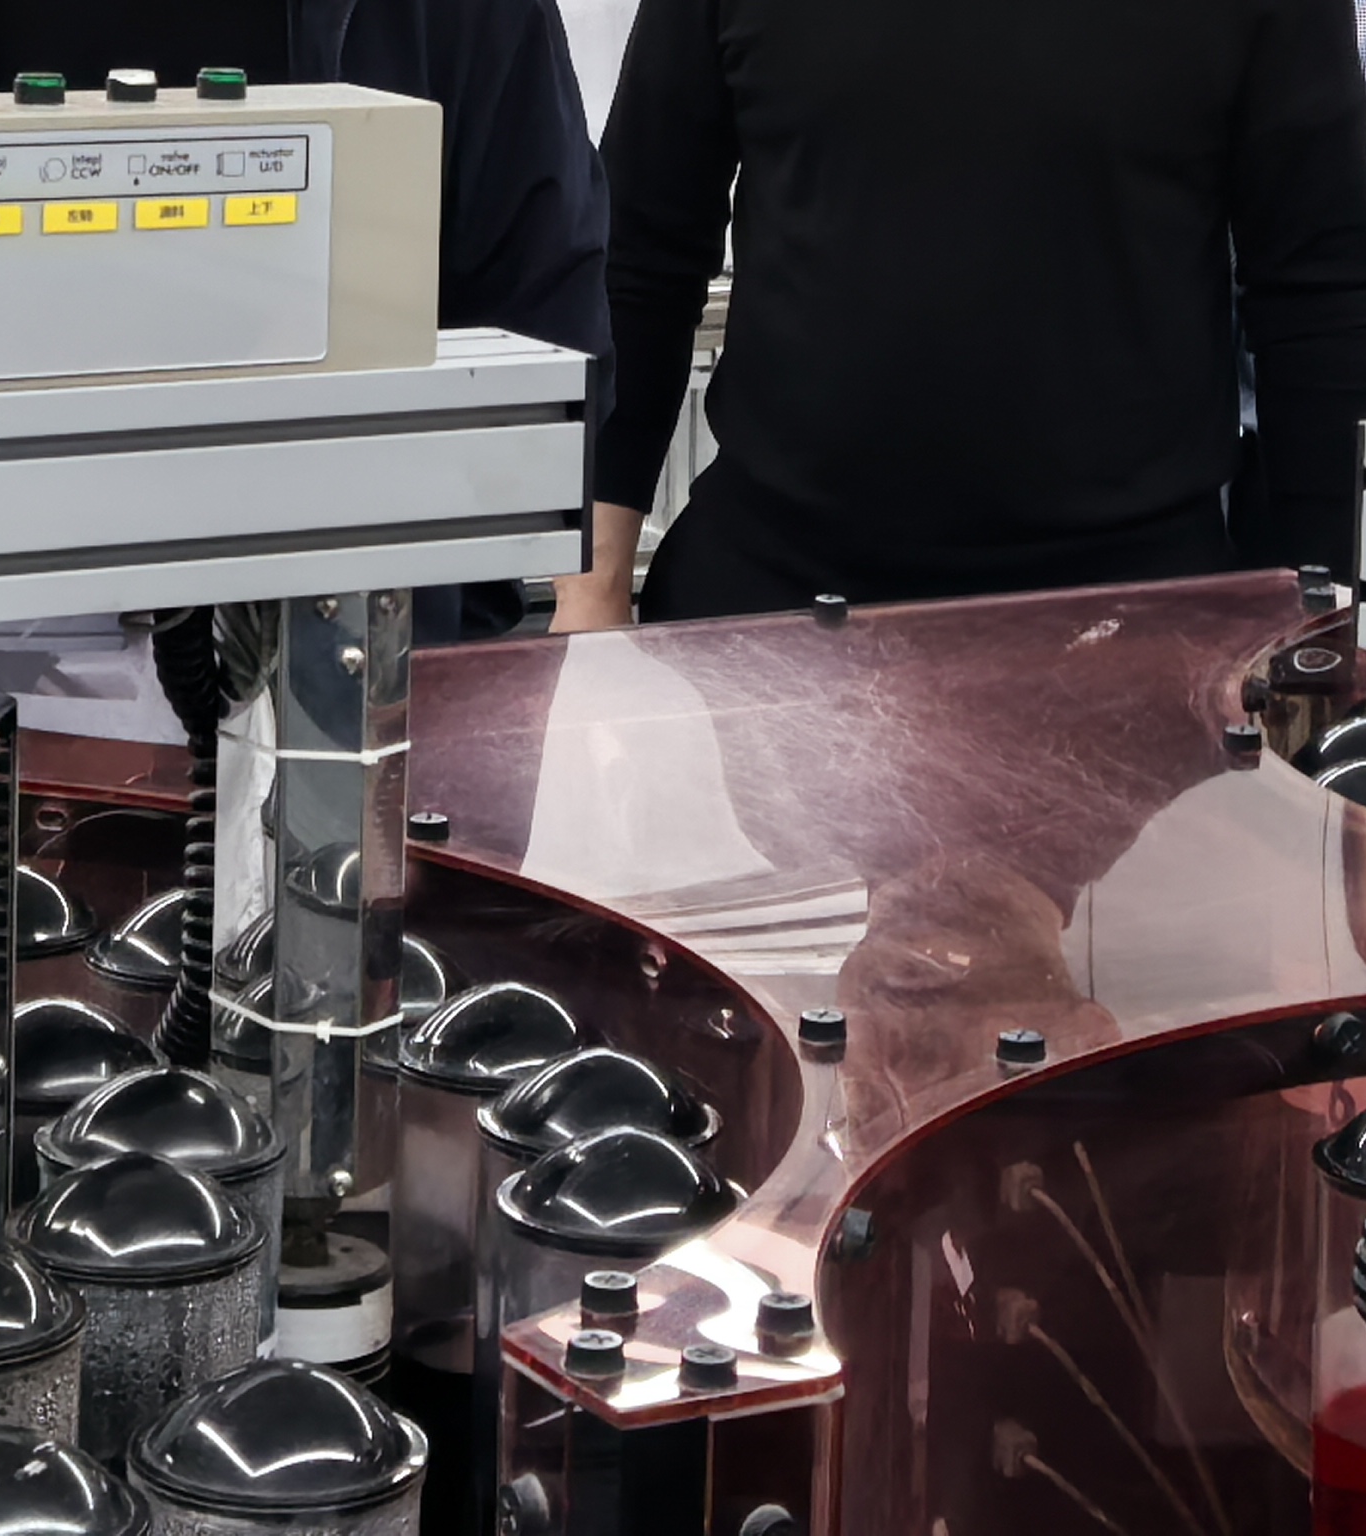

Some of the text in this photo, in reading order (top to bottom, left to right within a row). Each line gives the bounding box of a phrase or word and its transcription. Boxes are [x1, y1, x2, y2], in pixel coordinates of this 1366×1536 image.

[71, 167, 102, 179] CCW
[148, 164, 201, 177] ON/OFF
[247, 201, 274, 216] 上下
